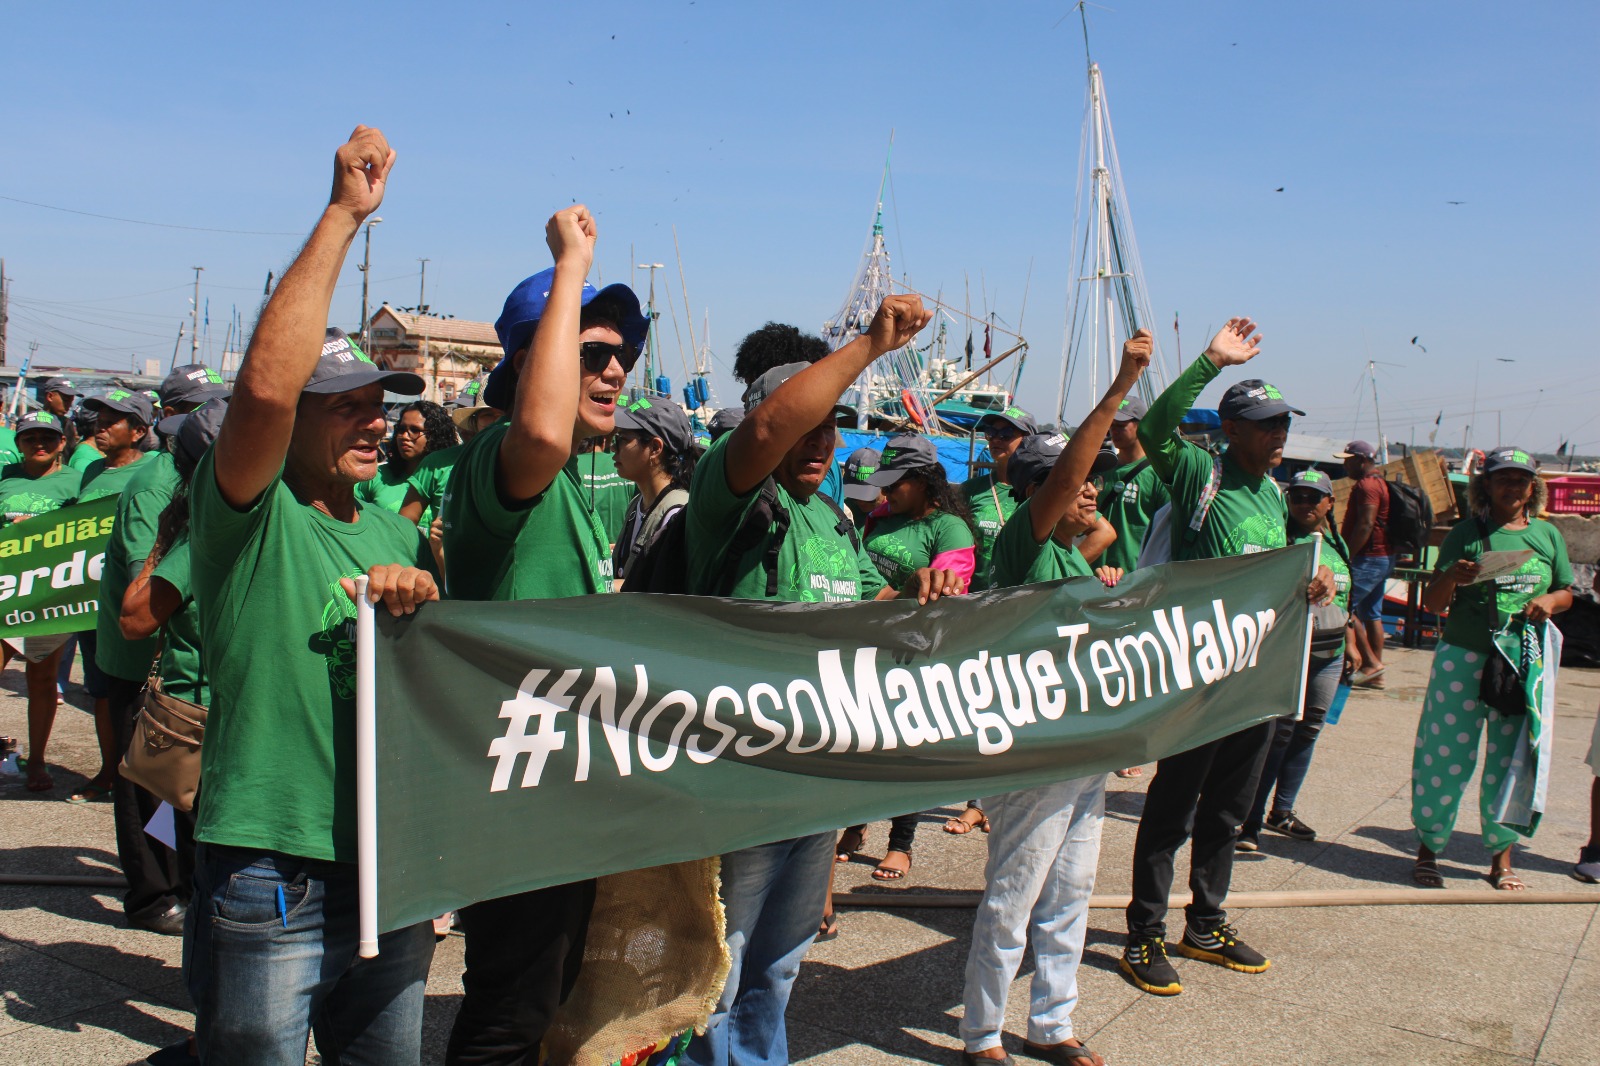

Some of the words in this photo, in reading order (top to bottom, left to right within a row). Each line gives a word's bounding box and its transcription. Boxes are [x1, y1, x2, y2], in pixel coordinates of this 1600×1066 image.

[336, 352, 355, 363] TEM
[1044, 433, 1066, 447] NOSSO
[832, 580, 857, 596] MANGUE
[1512, 584, 1534, 594] VALOR
[5, 609, 36, 626] do
[487, 599, 1276, 793] #NossoMangueTemValor
